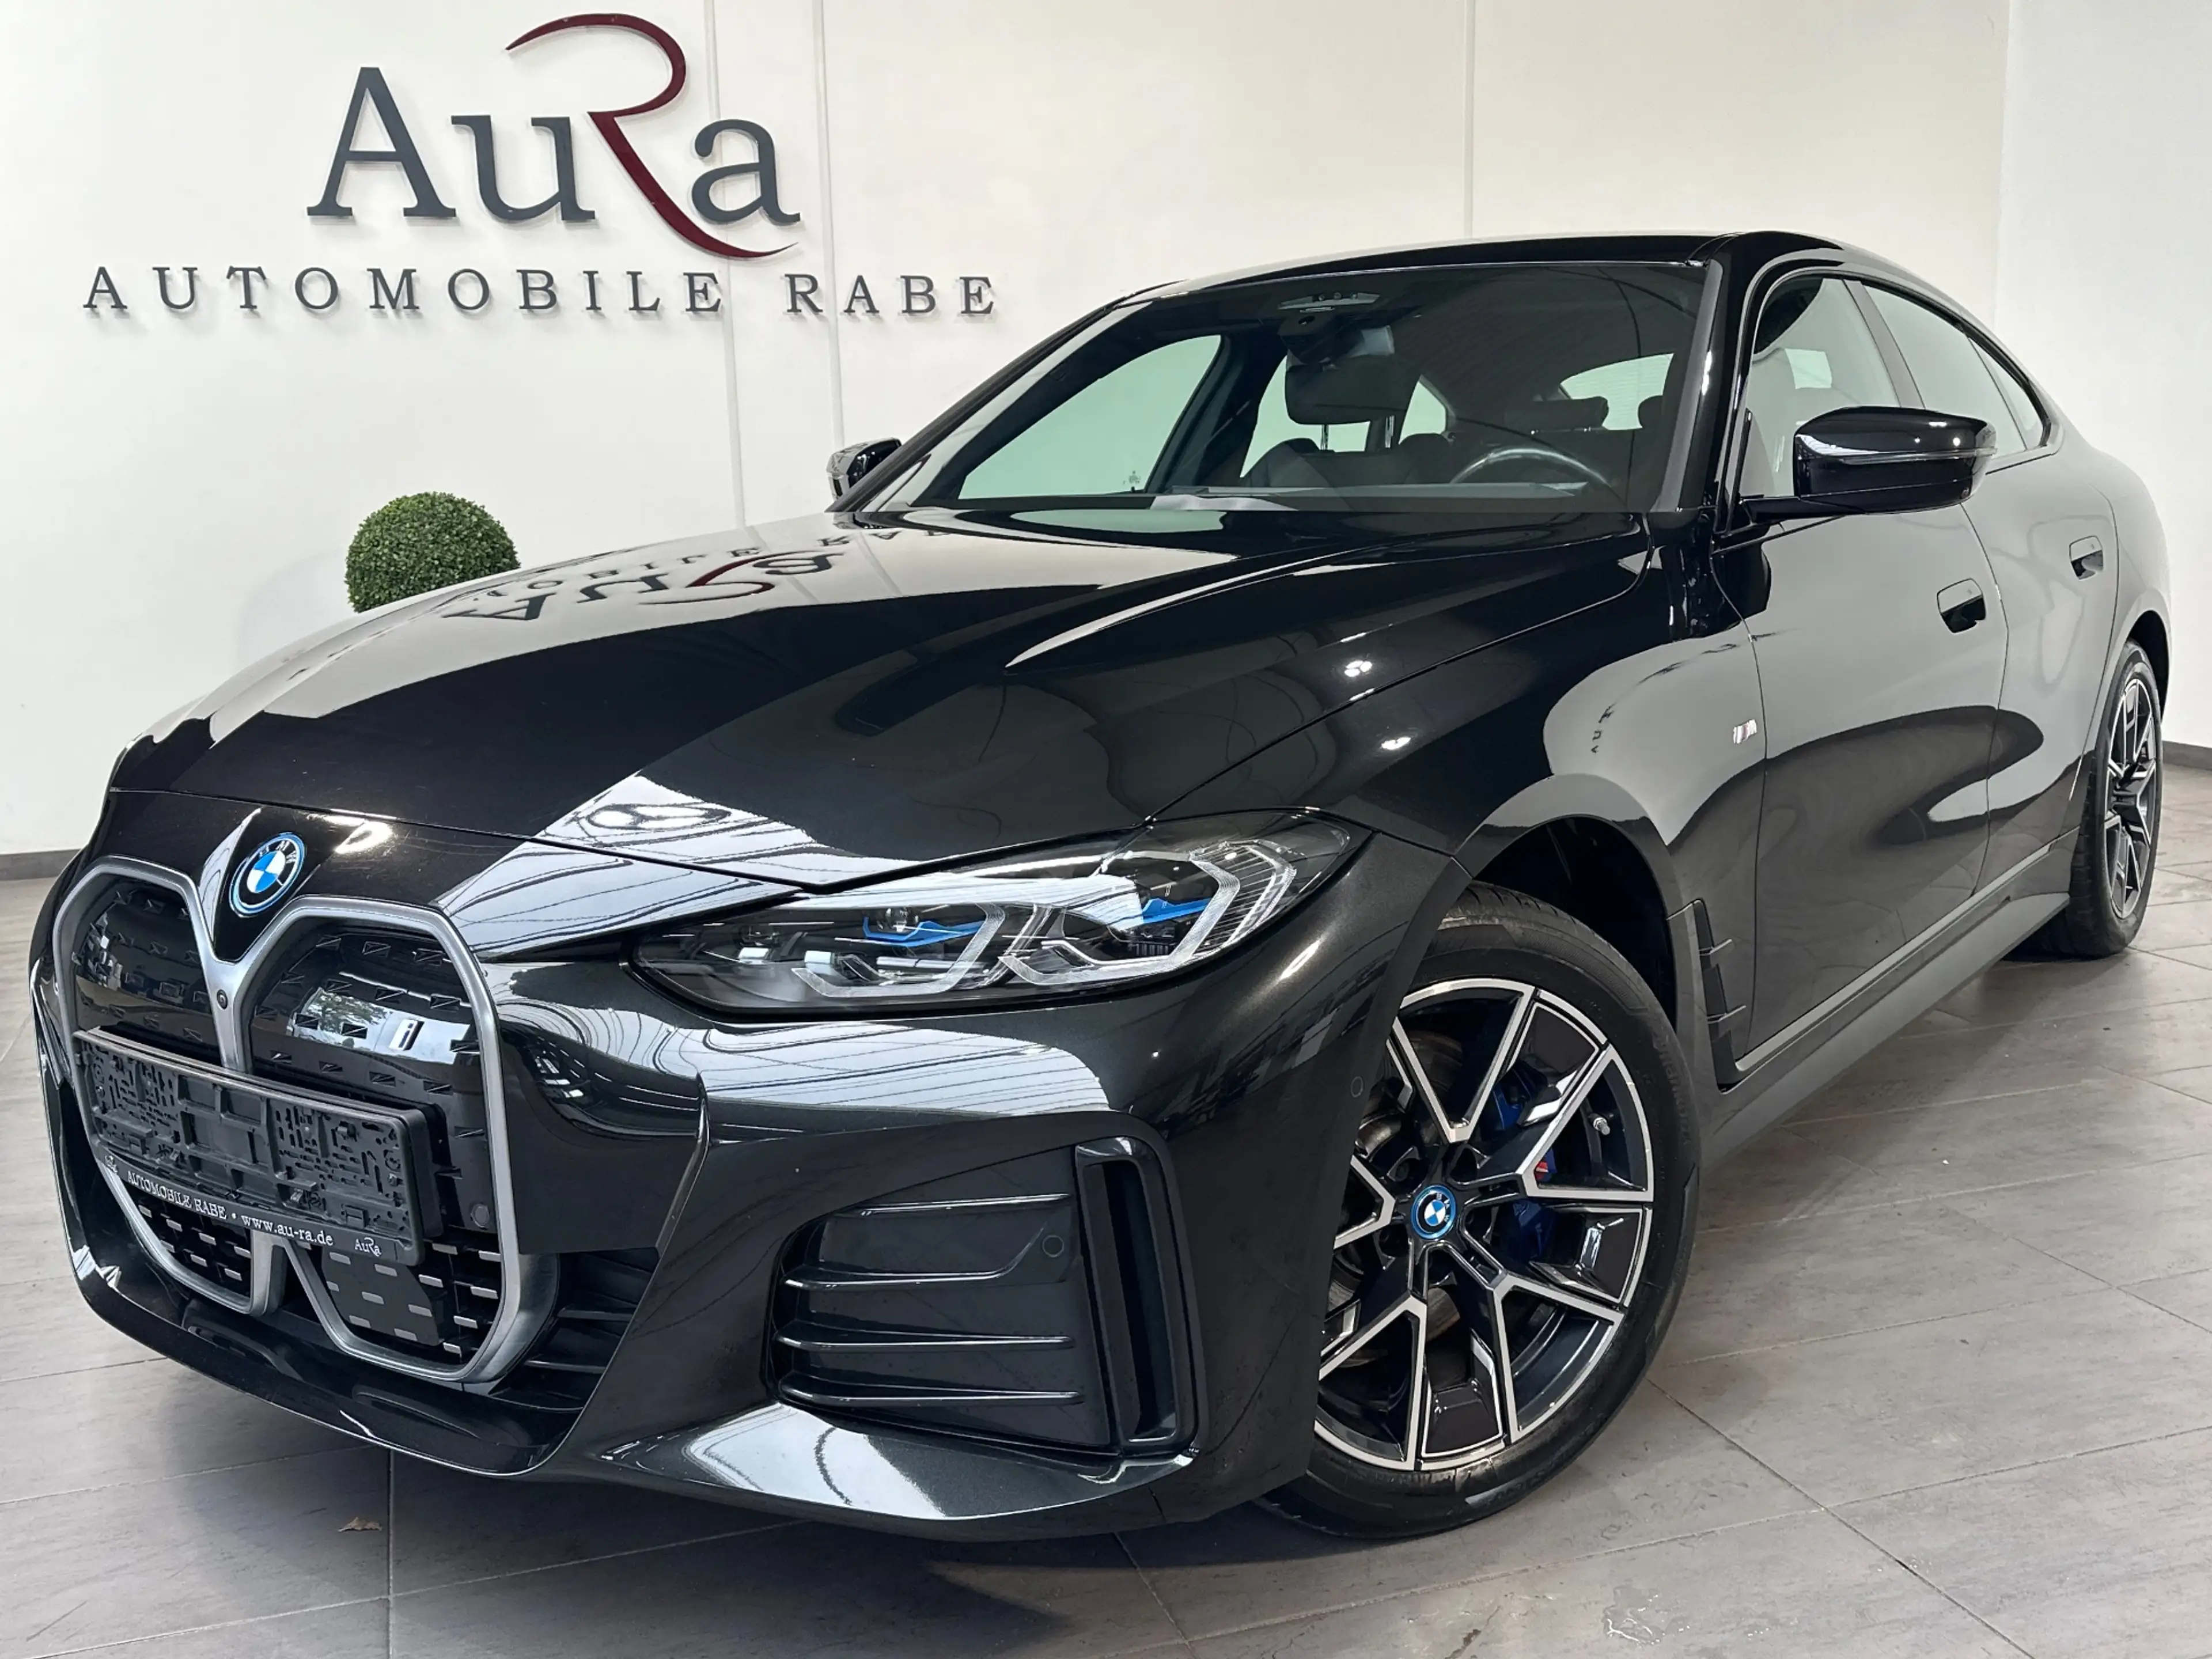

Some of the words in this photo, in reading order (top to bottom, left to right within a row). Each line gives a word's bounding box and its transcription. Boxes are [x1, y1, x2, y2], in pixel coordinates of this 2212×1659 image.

[306, 13, 801, 259] AuRa
[82, 265, 722, 313] AUTOMOBILE
[784, 273, 994, 315] RABE
[127, 1170, 192, 1209] AUTOMOBILE
[193, 1198, 228, 1220] RABE
[241, 1214, 335, 1247] www.au-ra.de
[354, 1237, 382, 1257] AuRa
